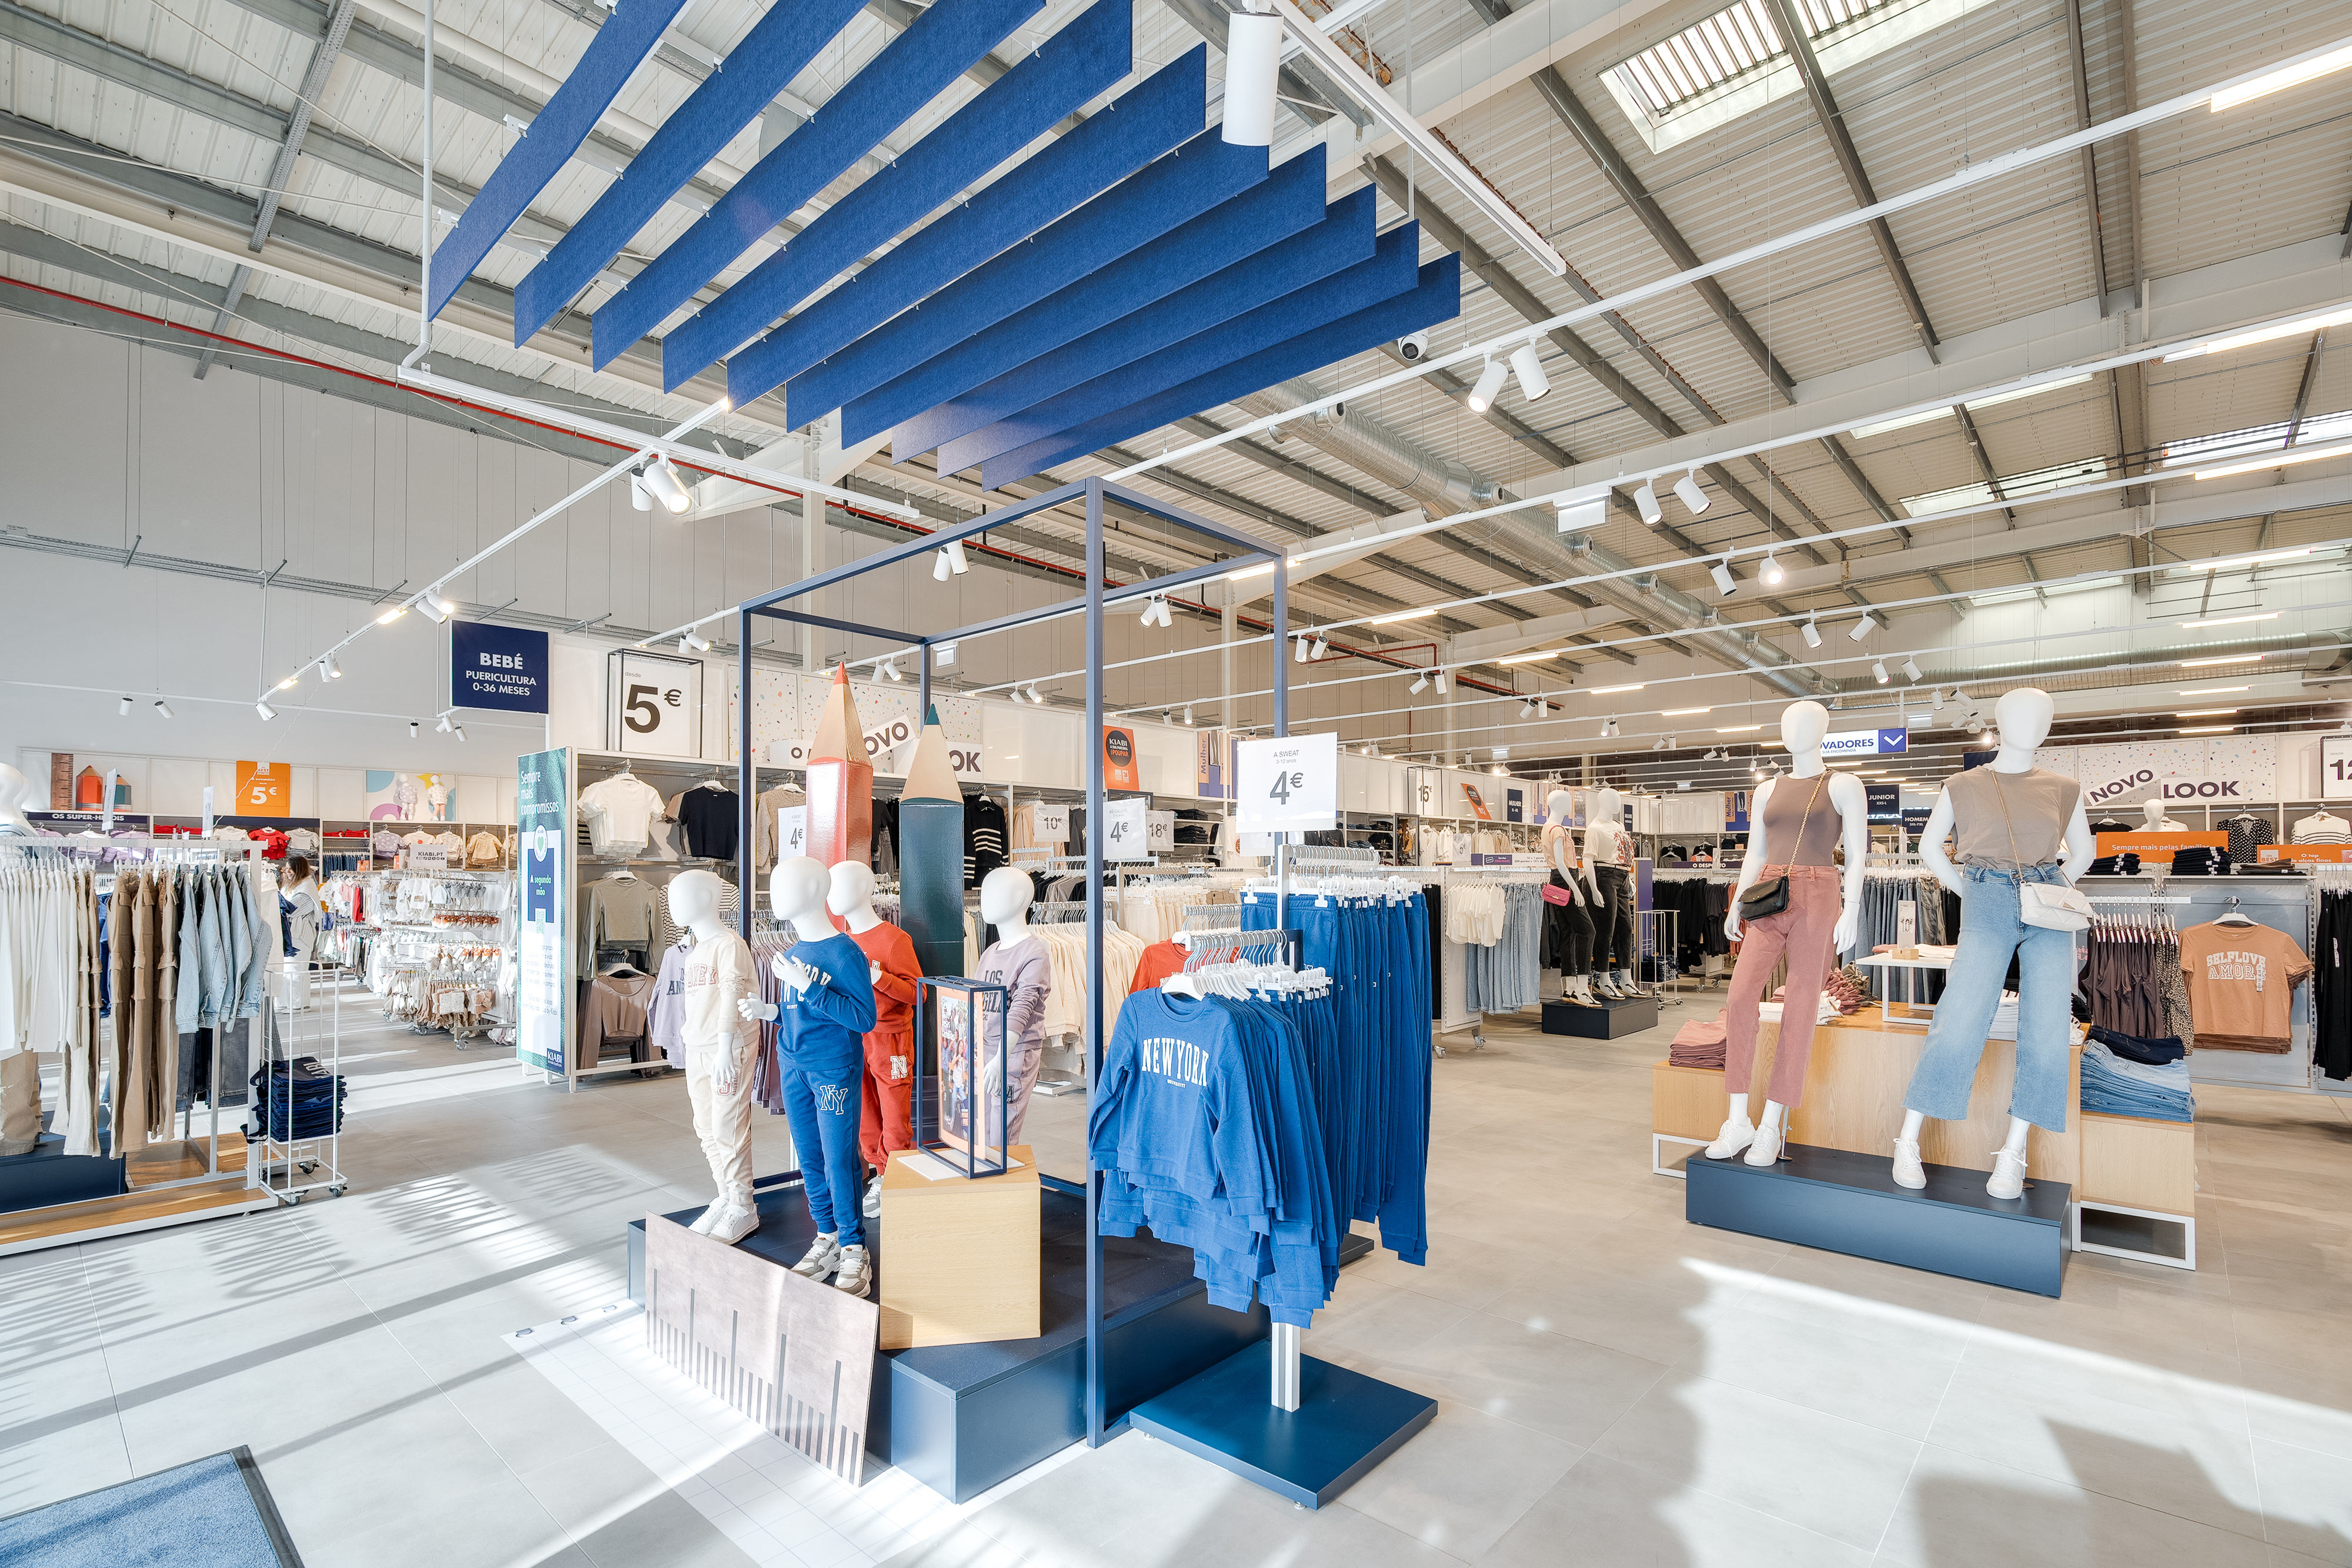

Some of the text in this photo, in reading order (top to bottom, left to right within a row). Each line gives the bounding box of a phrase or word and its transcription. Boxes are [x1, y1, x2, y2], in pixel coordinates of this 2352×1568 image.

[480, 653, 523, 670] BEBÉ
[466, 670, 537, 686] PUERICULTURA
[473, 683, 530, 696] 0-36 MESES
[624, 684, 682, 733] 5€
[863, 722, 908, 755] OVO
[1109, 738, 1127, 747] KIABI
[1820, 738, 1874, 750] VADORES
[948, 750, 981, 773] OK
[521, 771, 541, 786] Sempre
[2090, 770, 2153, 803] NOVO
[250, 787, 277, 804] 5€
[521, 785, 533, 800] mais
[1270, 771, 1304, 805] 4€
[2163, 781, 2240, 798] LOOK
[521, 799, 559, 817] compromissos
[1044, 817, 1063, 830] 10€
[1111, 821, 1128, 842] 4€
[1149, 823, 1168, 838] 18€
[790, 828, 803, 849] 4€
[530, 874, 552, 886] A segunda
[536, 887, 546, 896] mão
[1901, 918, 1913, 932] 10€
[547, 1051, 562, 1064] KIABI
[890, 1055, 908, 1075] N
[1141, 1037, 1210, 1087] NEW YORK
[820, 1084, 848, 1115] NY
